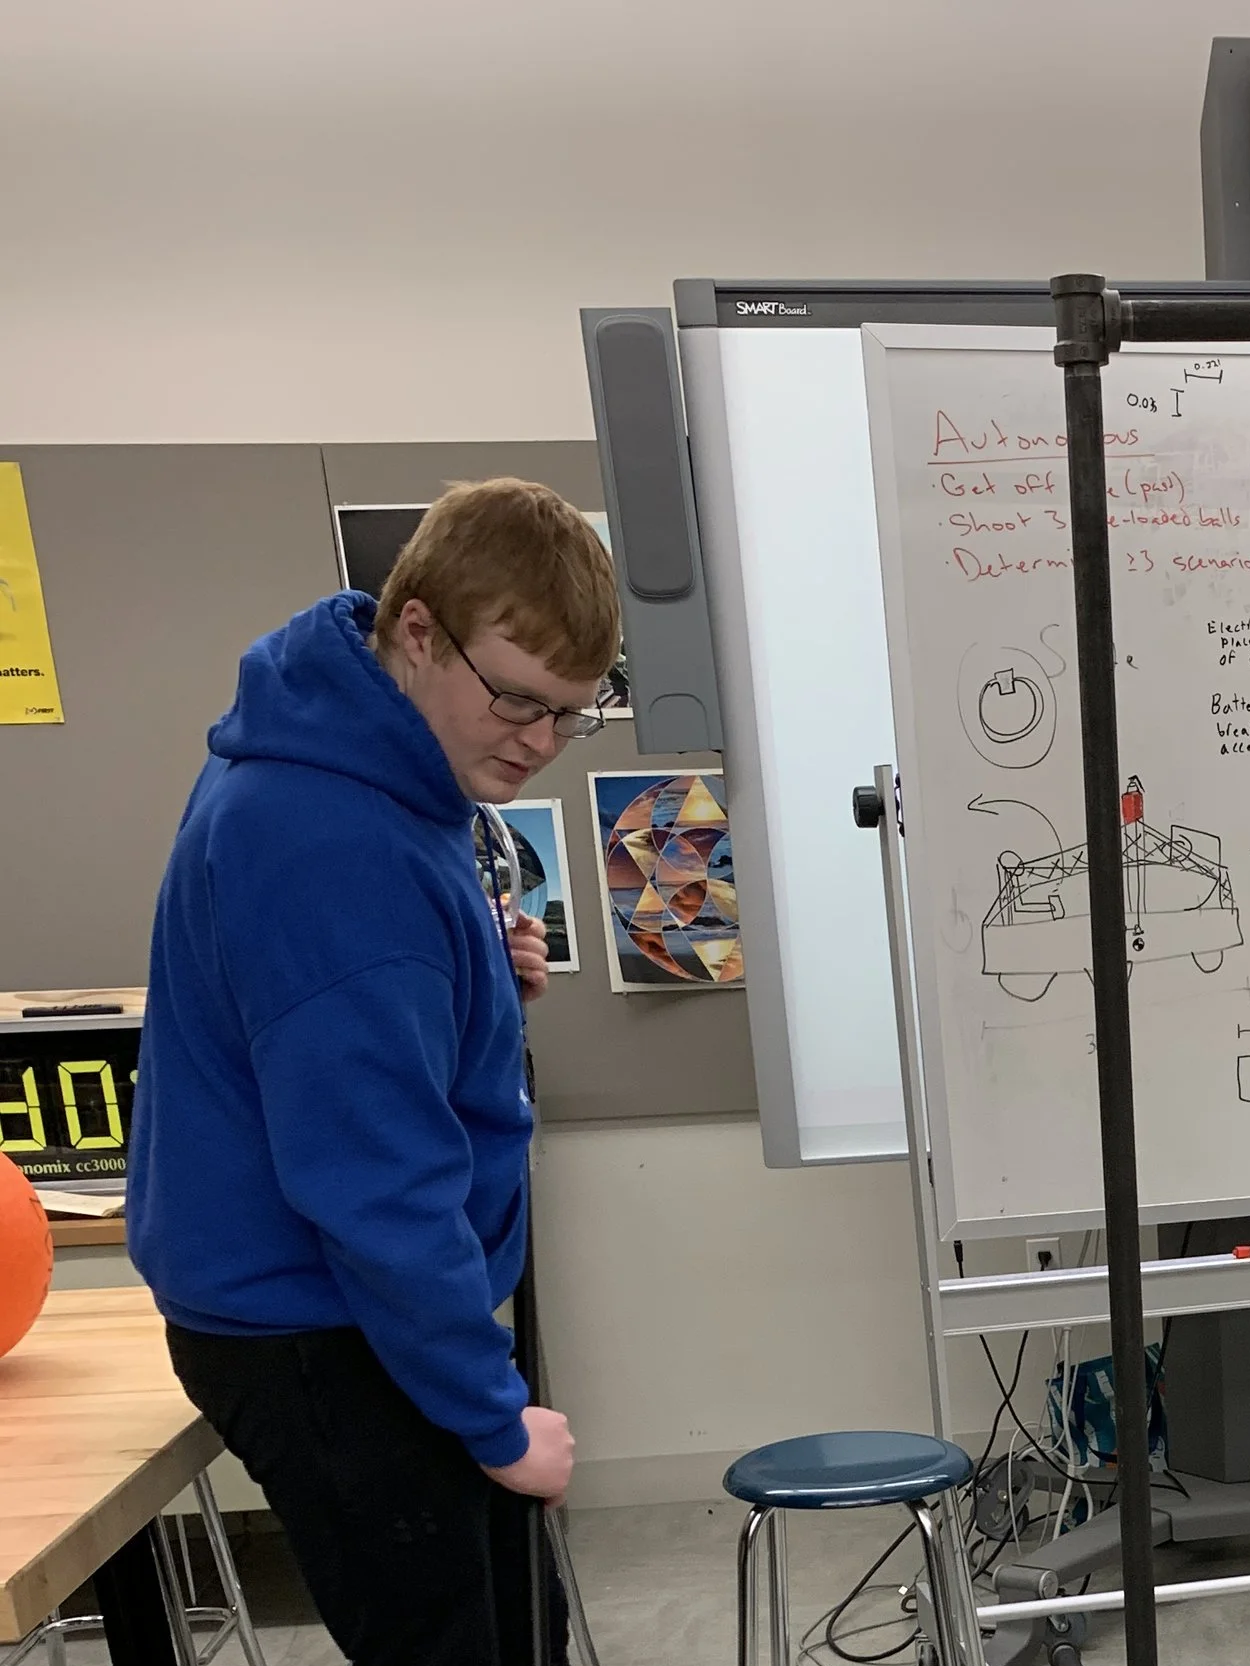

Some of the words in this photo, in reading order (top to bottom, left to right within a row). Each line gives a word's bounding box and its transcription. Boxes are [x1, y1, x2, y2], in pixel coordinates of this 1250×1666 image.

[736, 302, 778, 315] SMART
[778, 303, 807, 315] Board
[934, 410, 1140, 457] Autonoous
[941, 472, 996, 497] Get
[1014, 471, 1054, 496] off
[949, 512, 1032, 536] Shoot
[1044, 510, 1067, 529] 3
[1200, 507, 1240, 528] balls
